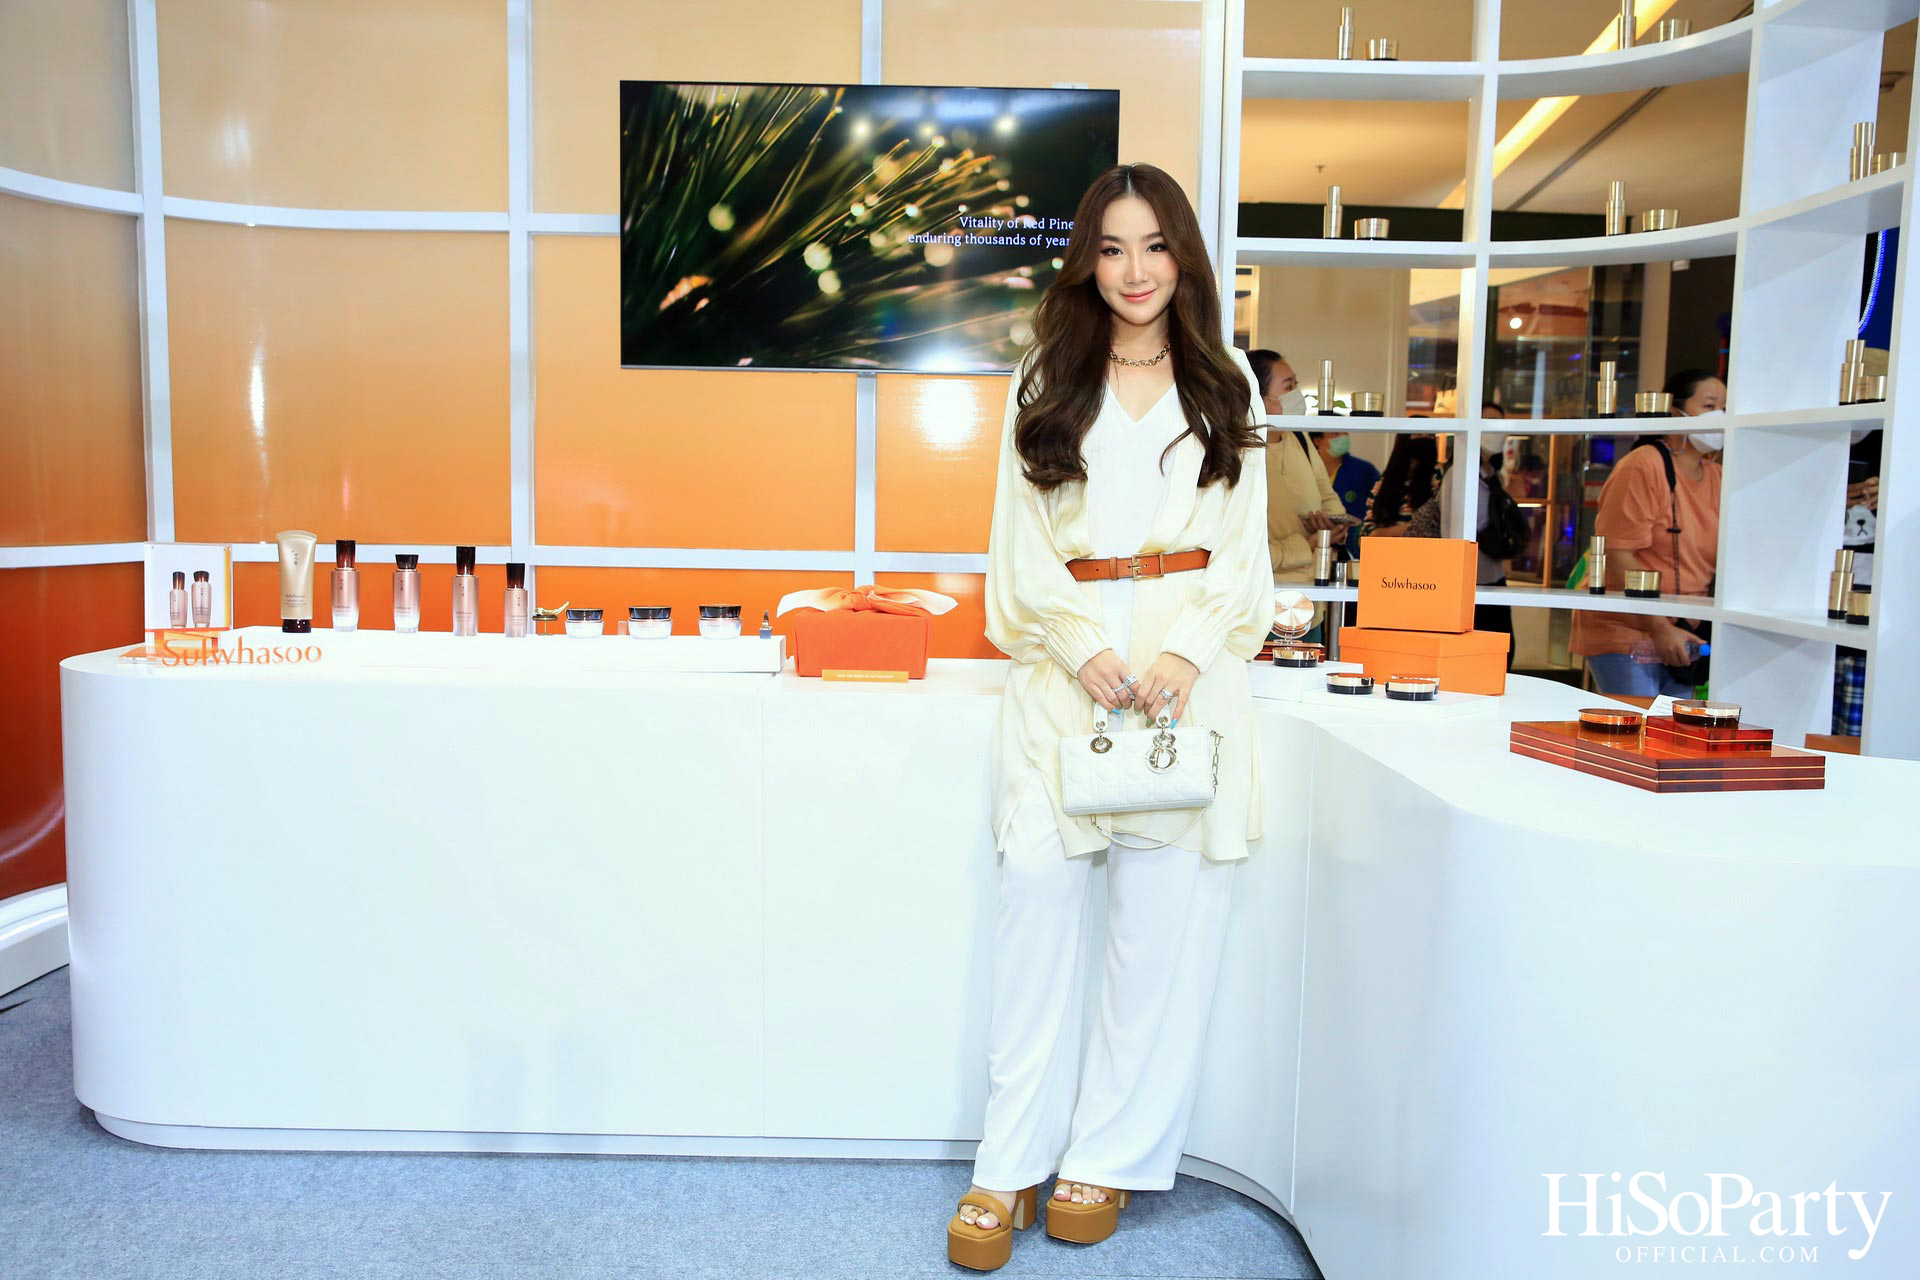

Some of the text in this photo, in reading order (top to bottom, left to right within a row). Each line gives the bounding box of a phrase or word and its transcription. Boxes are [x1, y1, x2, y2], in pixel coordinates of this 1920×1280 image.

[959, 216, 1003, 231] Vitality
[1007, 216, 1020, 229] of
[1023, 217, 1045, 229] Red
[908, 232, 962, 246] enduring
[965, 233, 1026, 245] thousands
[1029, 234, 1042, 246] of
[1381, 577, 1437, 591] Sulwhasoo
[161, 635, 322, 668] Sulwhasoo
